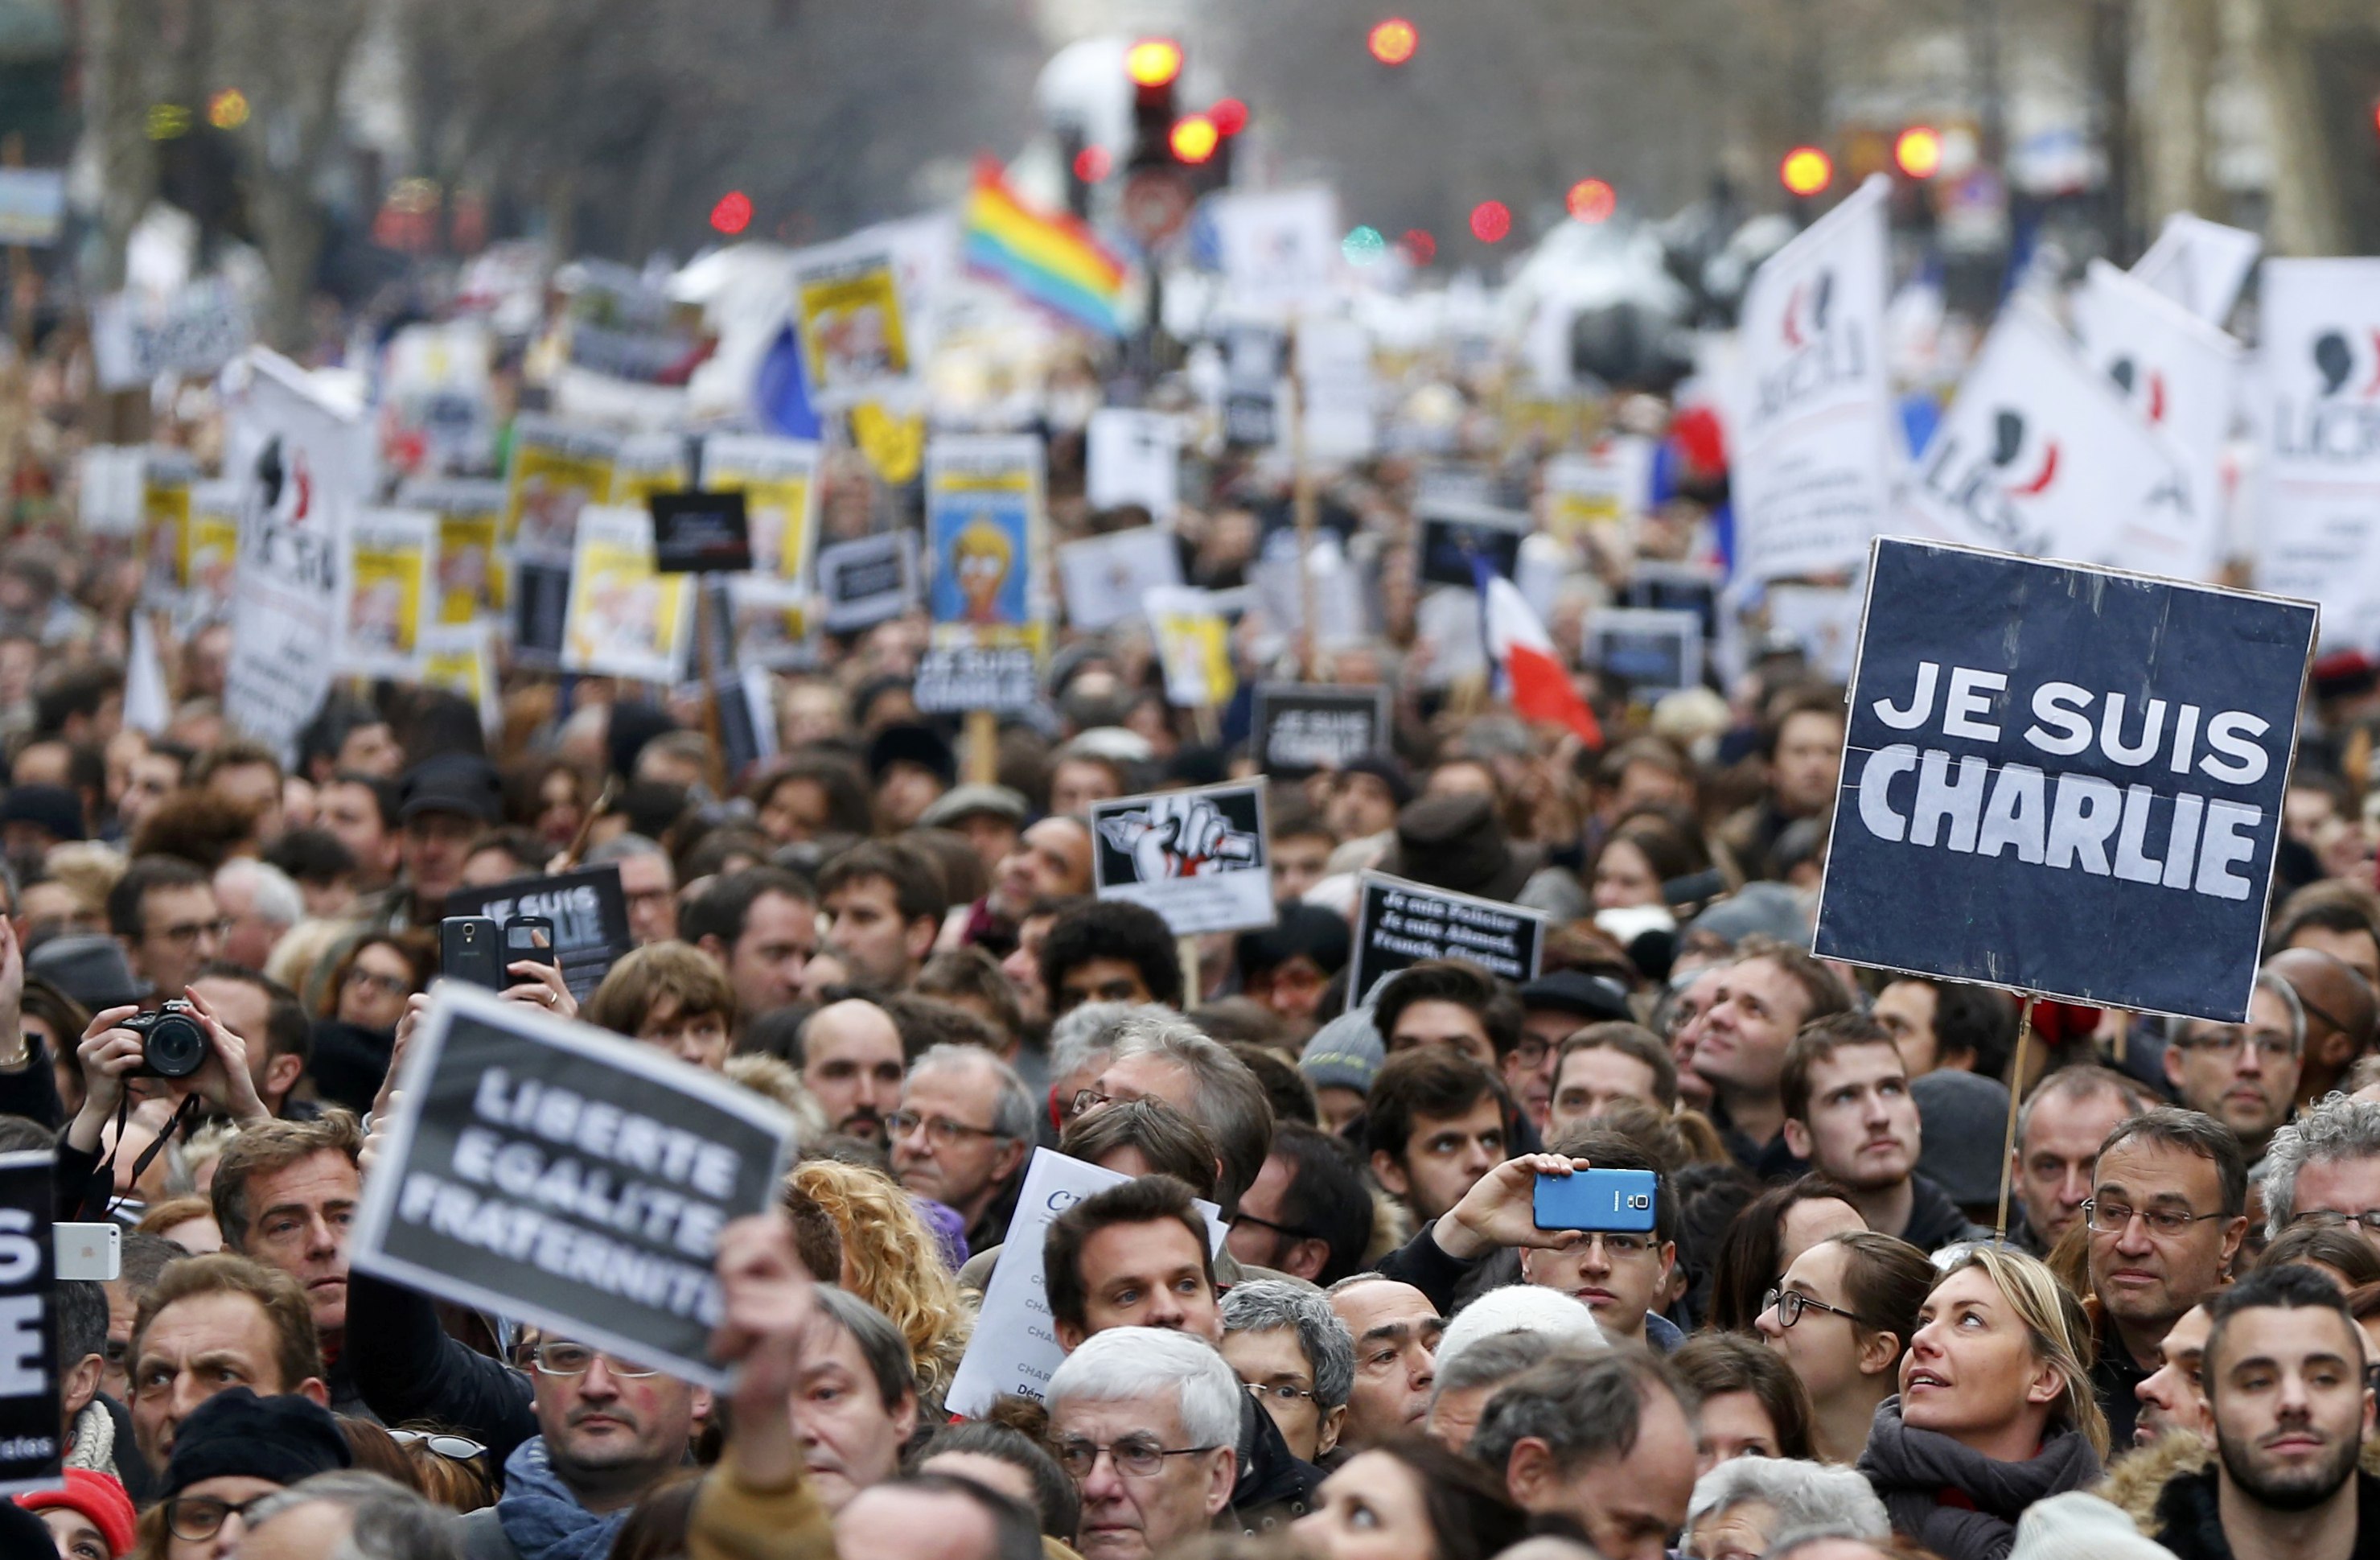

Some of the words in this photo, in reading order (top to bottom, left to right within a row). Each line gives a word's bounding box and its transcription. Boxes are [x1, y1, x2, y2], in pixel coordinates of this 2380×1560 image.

[1873, 661, 2008, 742] JE
[2024, 681, 2271, 784] SUIS
[1859, 743, 2263, 900] CHARLIE
[518, 886, 598, 916] SUIS
[1379, 910, 1404, 929] Je
[1382, 890, 1407, 910] Je
[453, 1129, 727, 1258] EGALITE
[473, 1066, 741, 1200] LIBERTE
